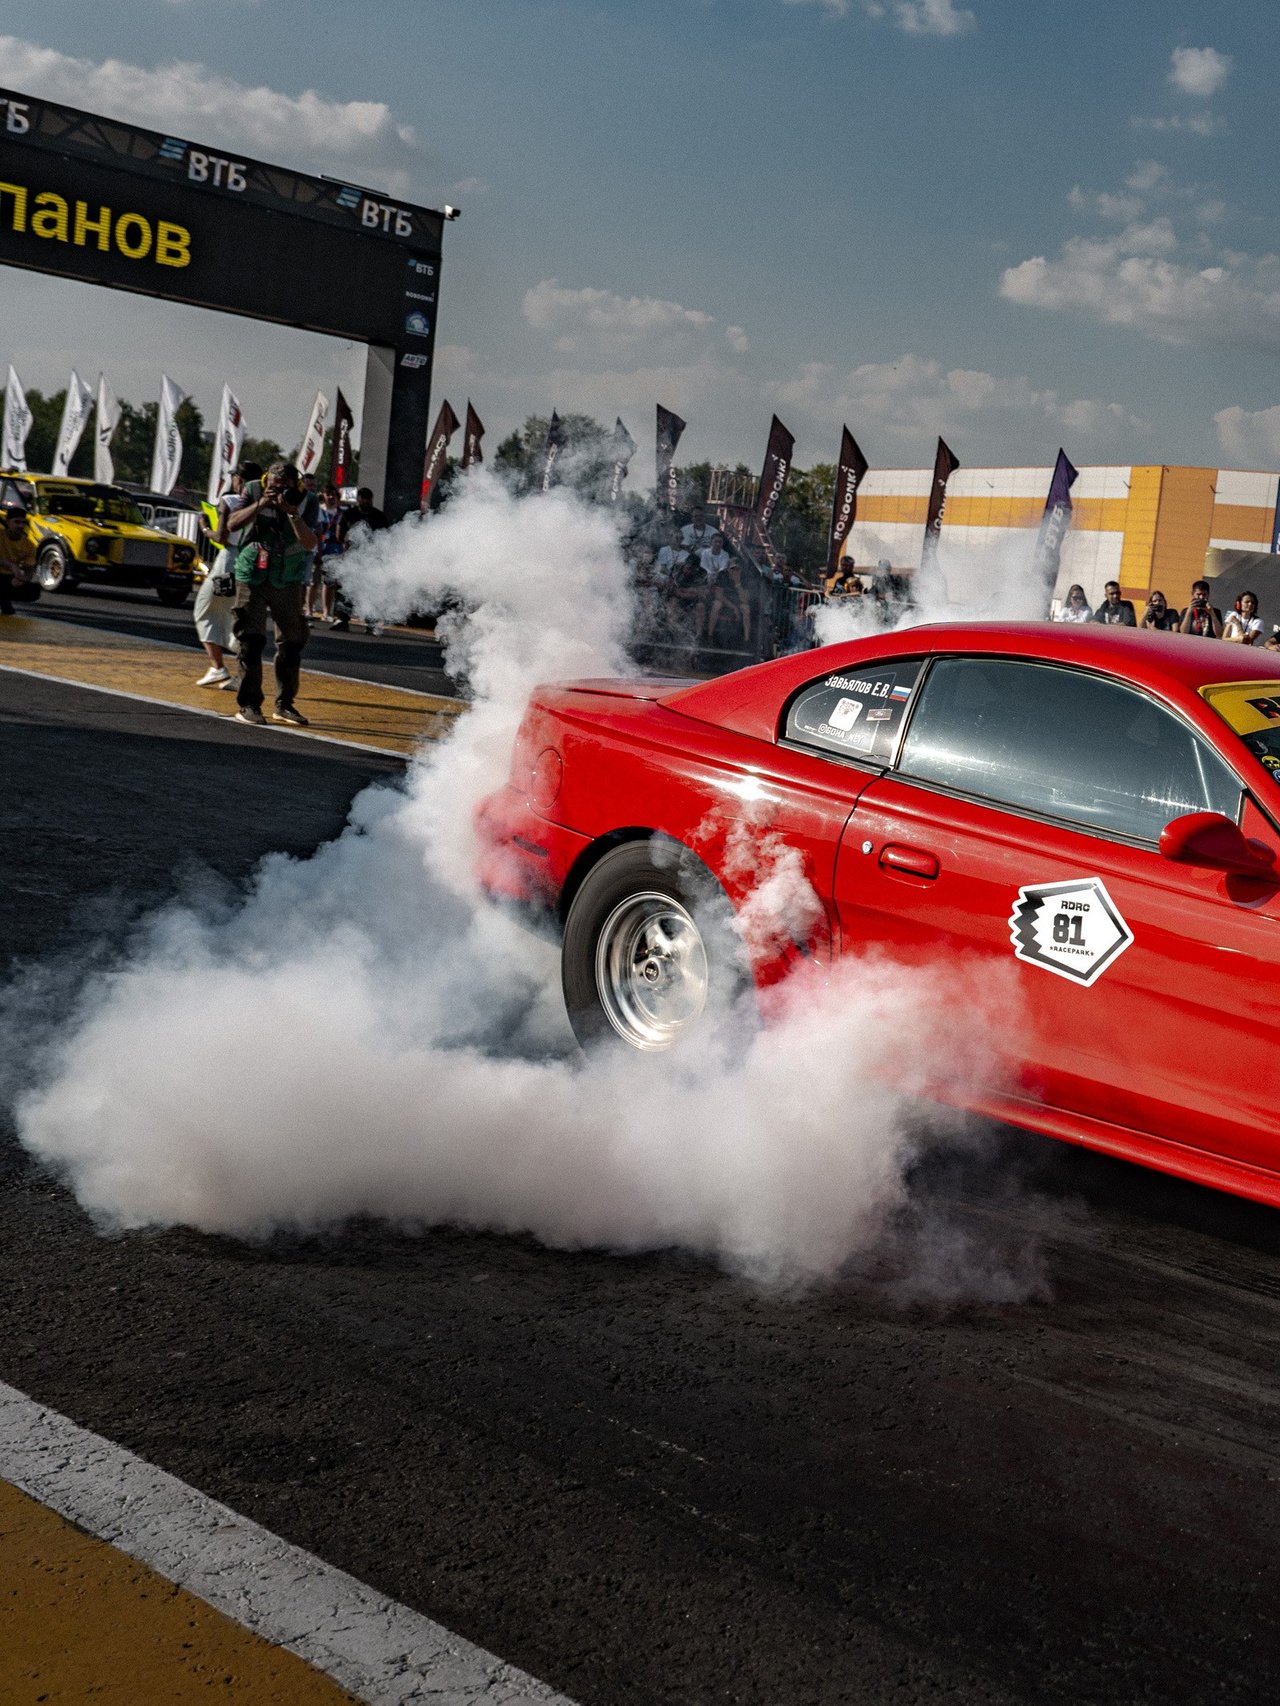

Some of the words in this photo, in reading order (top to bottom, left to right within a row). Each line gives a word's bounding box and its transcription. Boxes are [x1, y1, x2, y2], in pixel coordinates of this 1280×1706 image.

[188, 151, 247, 192] ВТБ
[361, 199, 413, 237] ВТБ
[415, 262, 434, 276] ВТБ
[1061, 900, 1090, 912] RDRC
[1052, 913, 1086, 947] 81
[1053, 946, 1090, 957] RACEPARK
